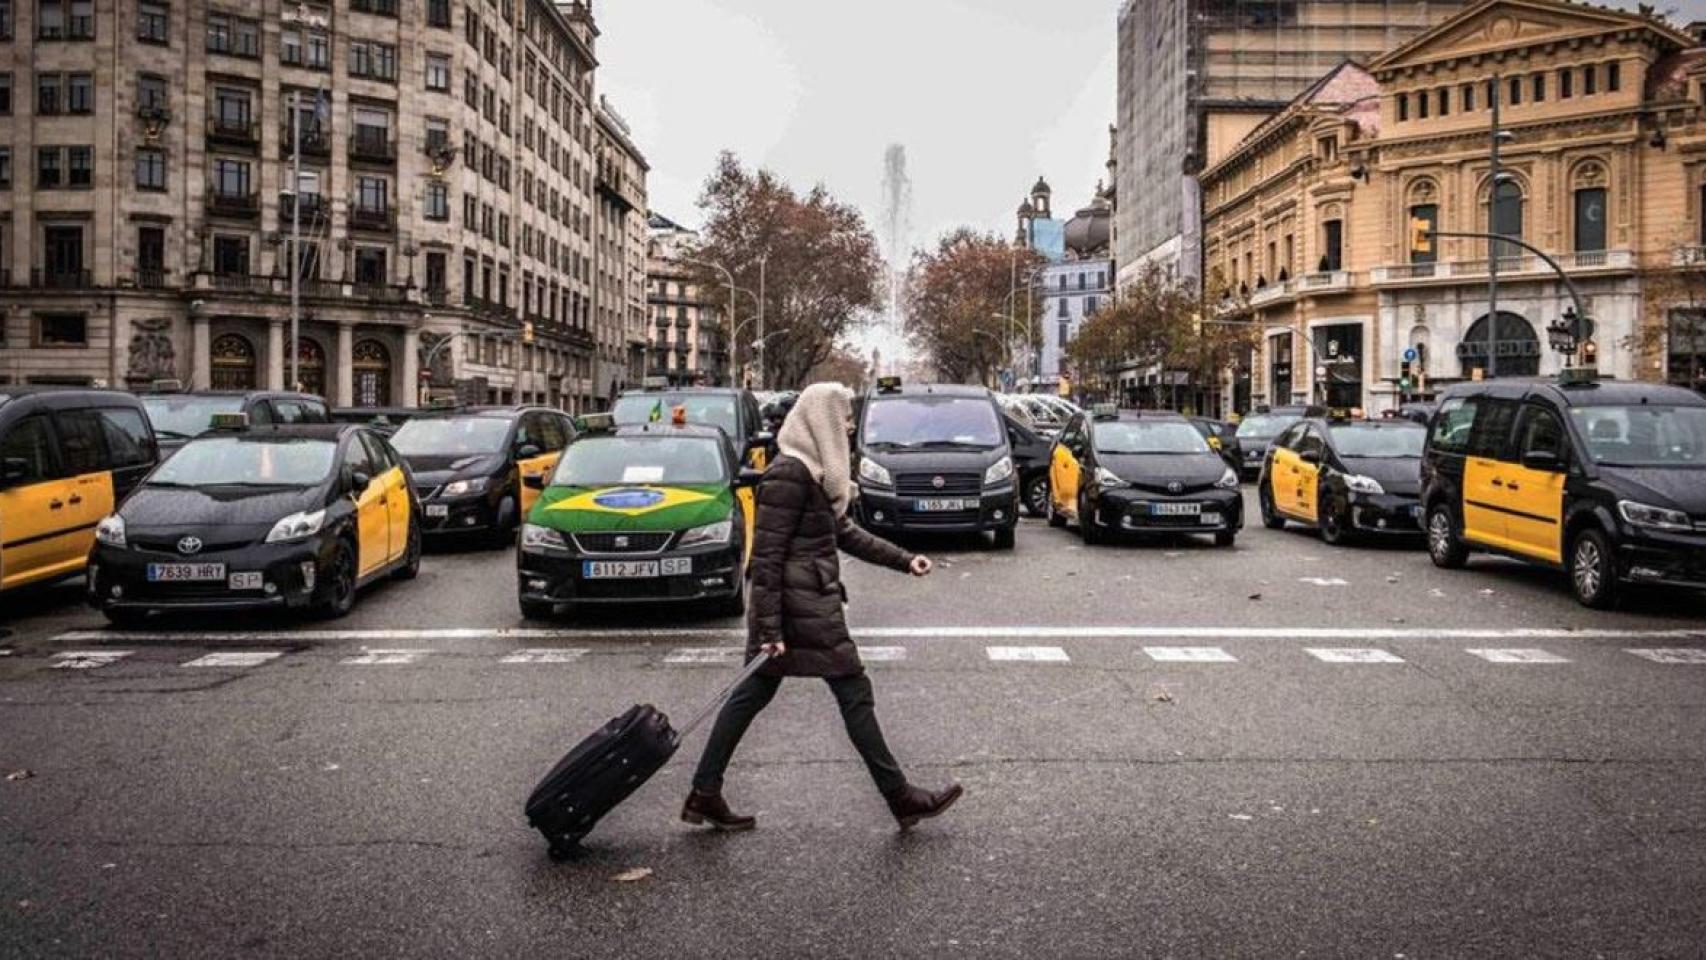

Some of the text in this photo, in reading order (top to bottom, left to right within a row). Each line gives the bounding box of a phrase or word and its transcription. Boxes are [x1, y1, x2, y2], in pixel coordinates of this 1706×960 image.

[158, 564, 223, 578] 7639 HRY
[631, 560, 656, 576] JFV
[663, 559, 688, 575] SP
[231, 573, 259, 588] SP
